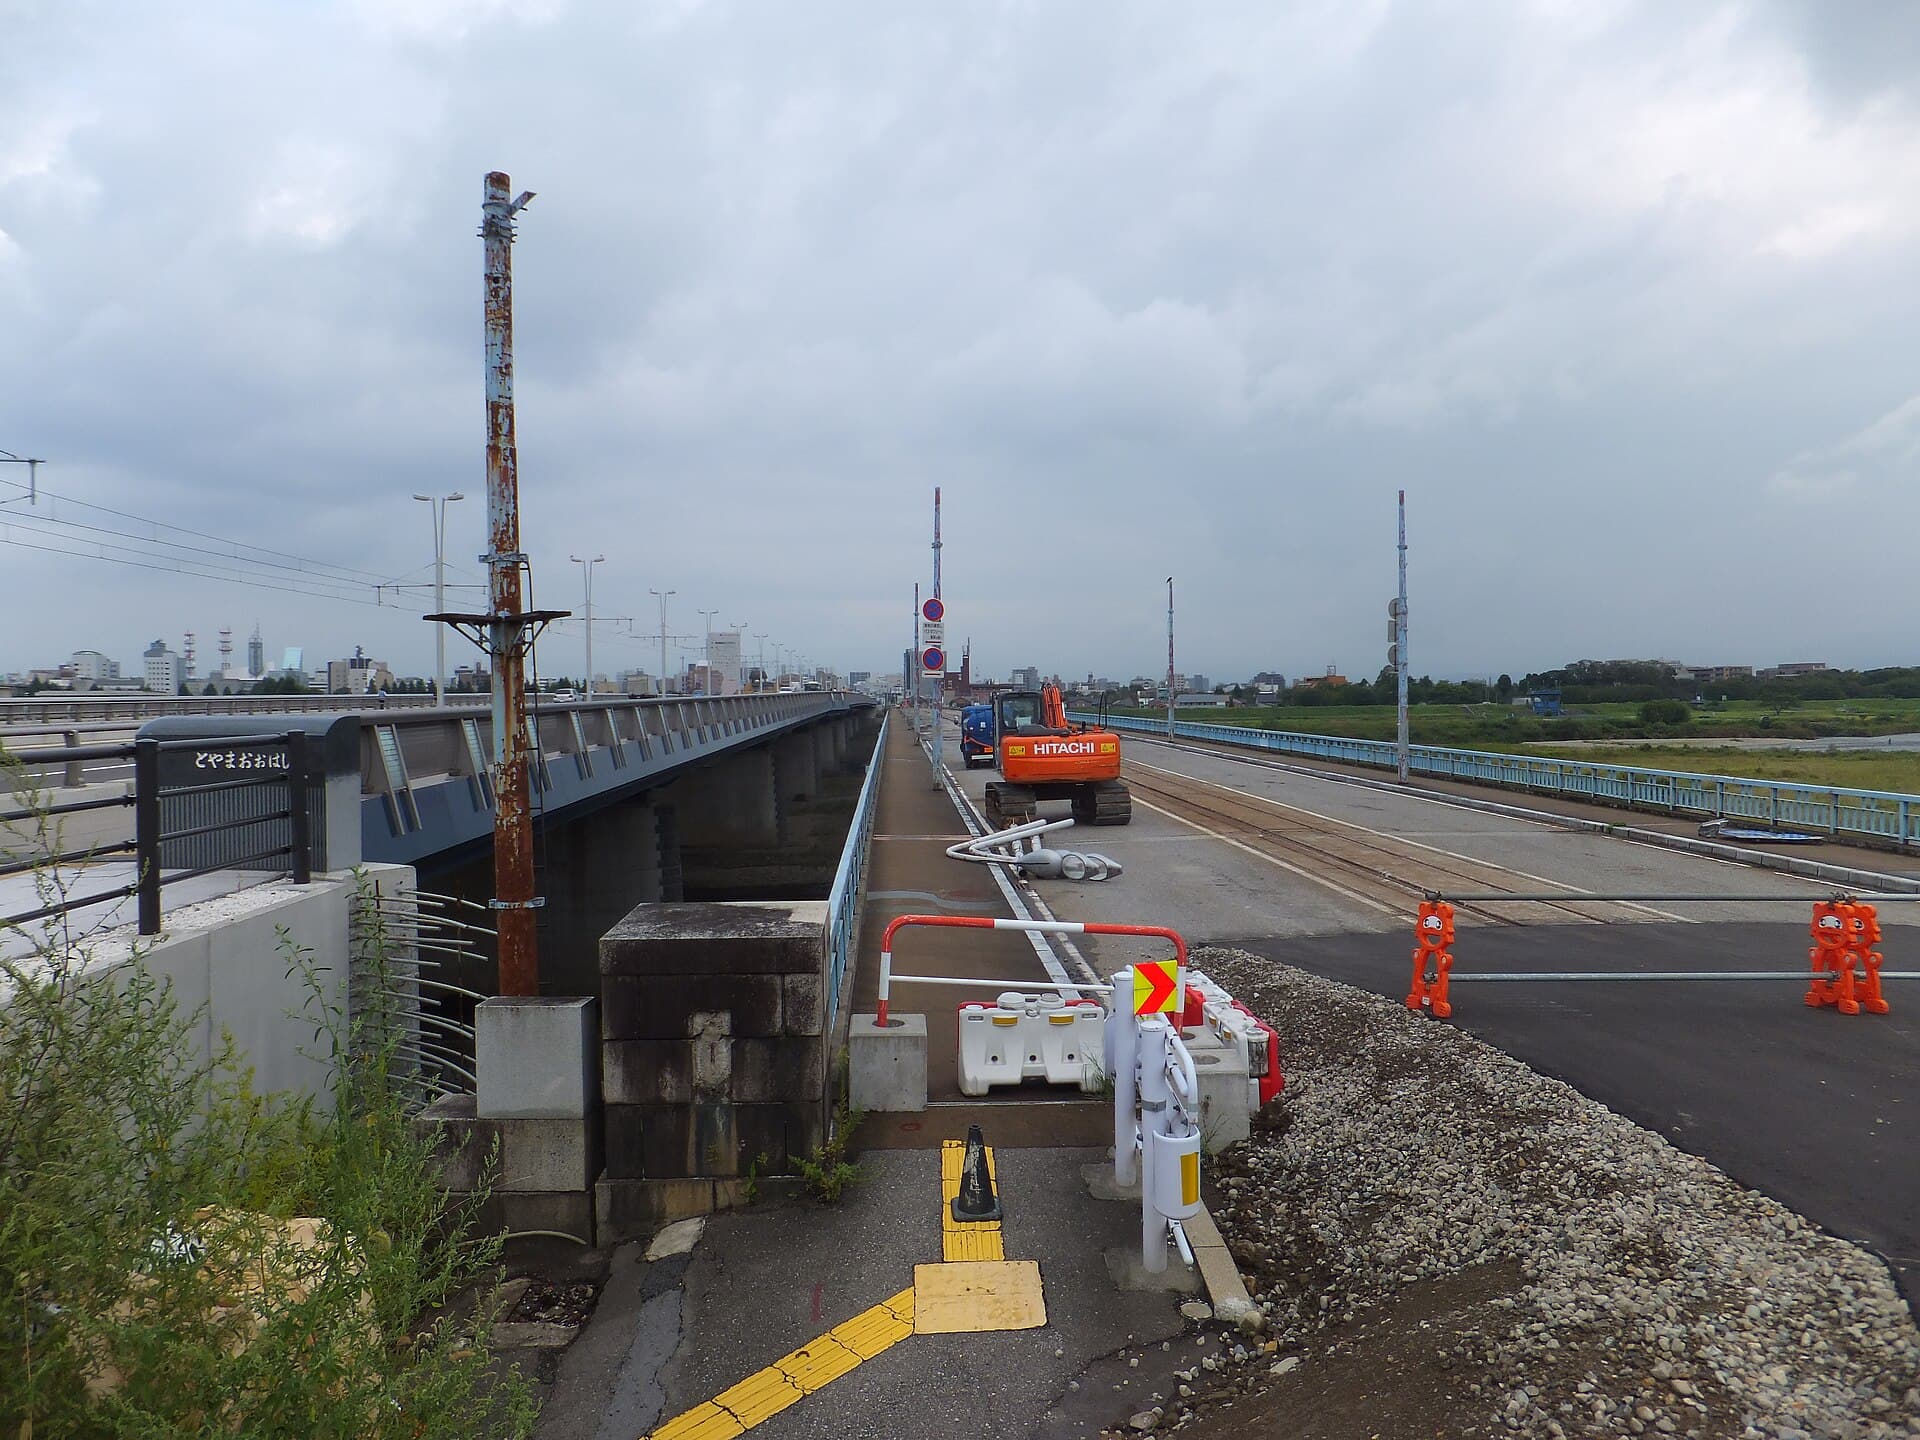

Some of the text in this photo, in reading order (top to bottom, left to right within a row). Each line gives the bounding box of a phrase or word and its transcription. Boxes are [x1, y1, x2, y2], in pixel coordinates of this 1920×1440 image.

[1033, 742, 1095, 755] HITACHI
[195, 751, 290, 770] とやまおおはし
